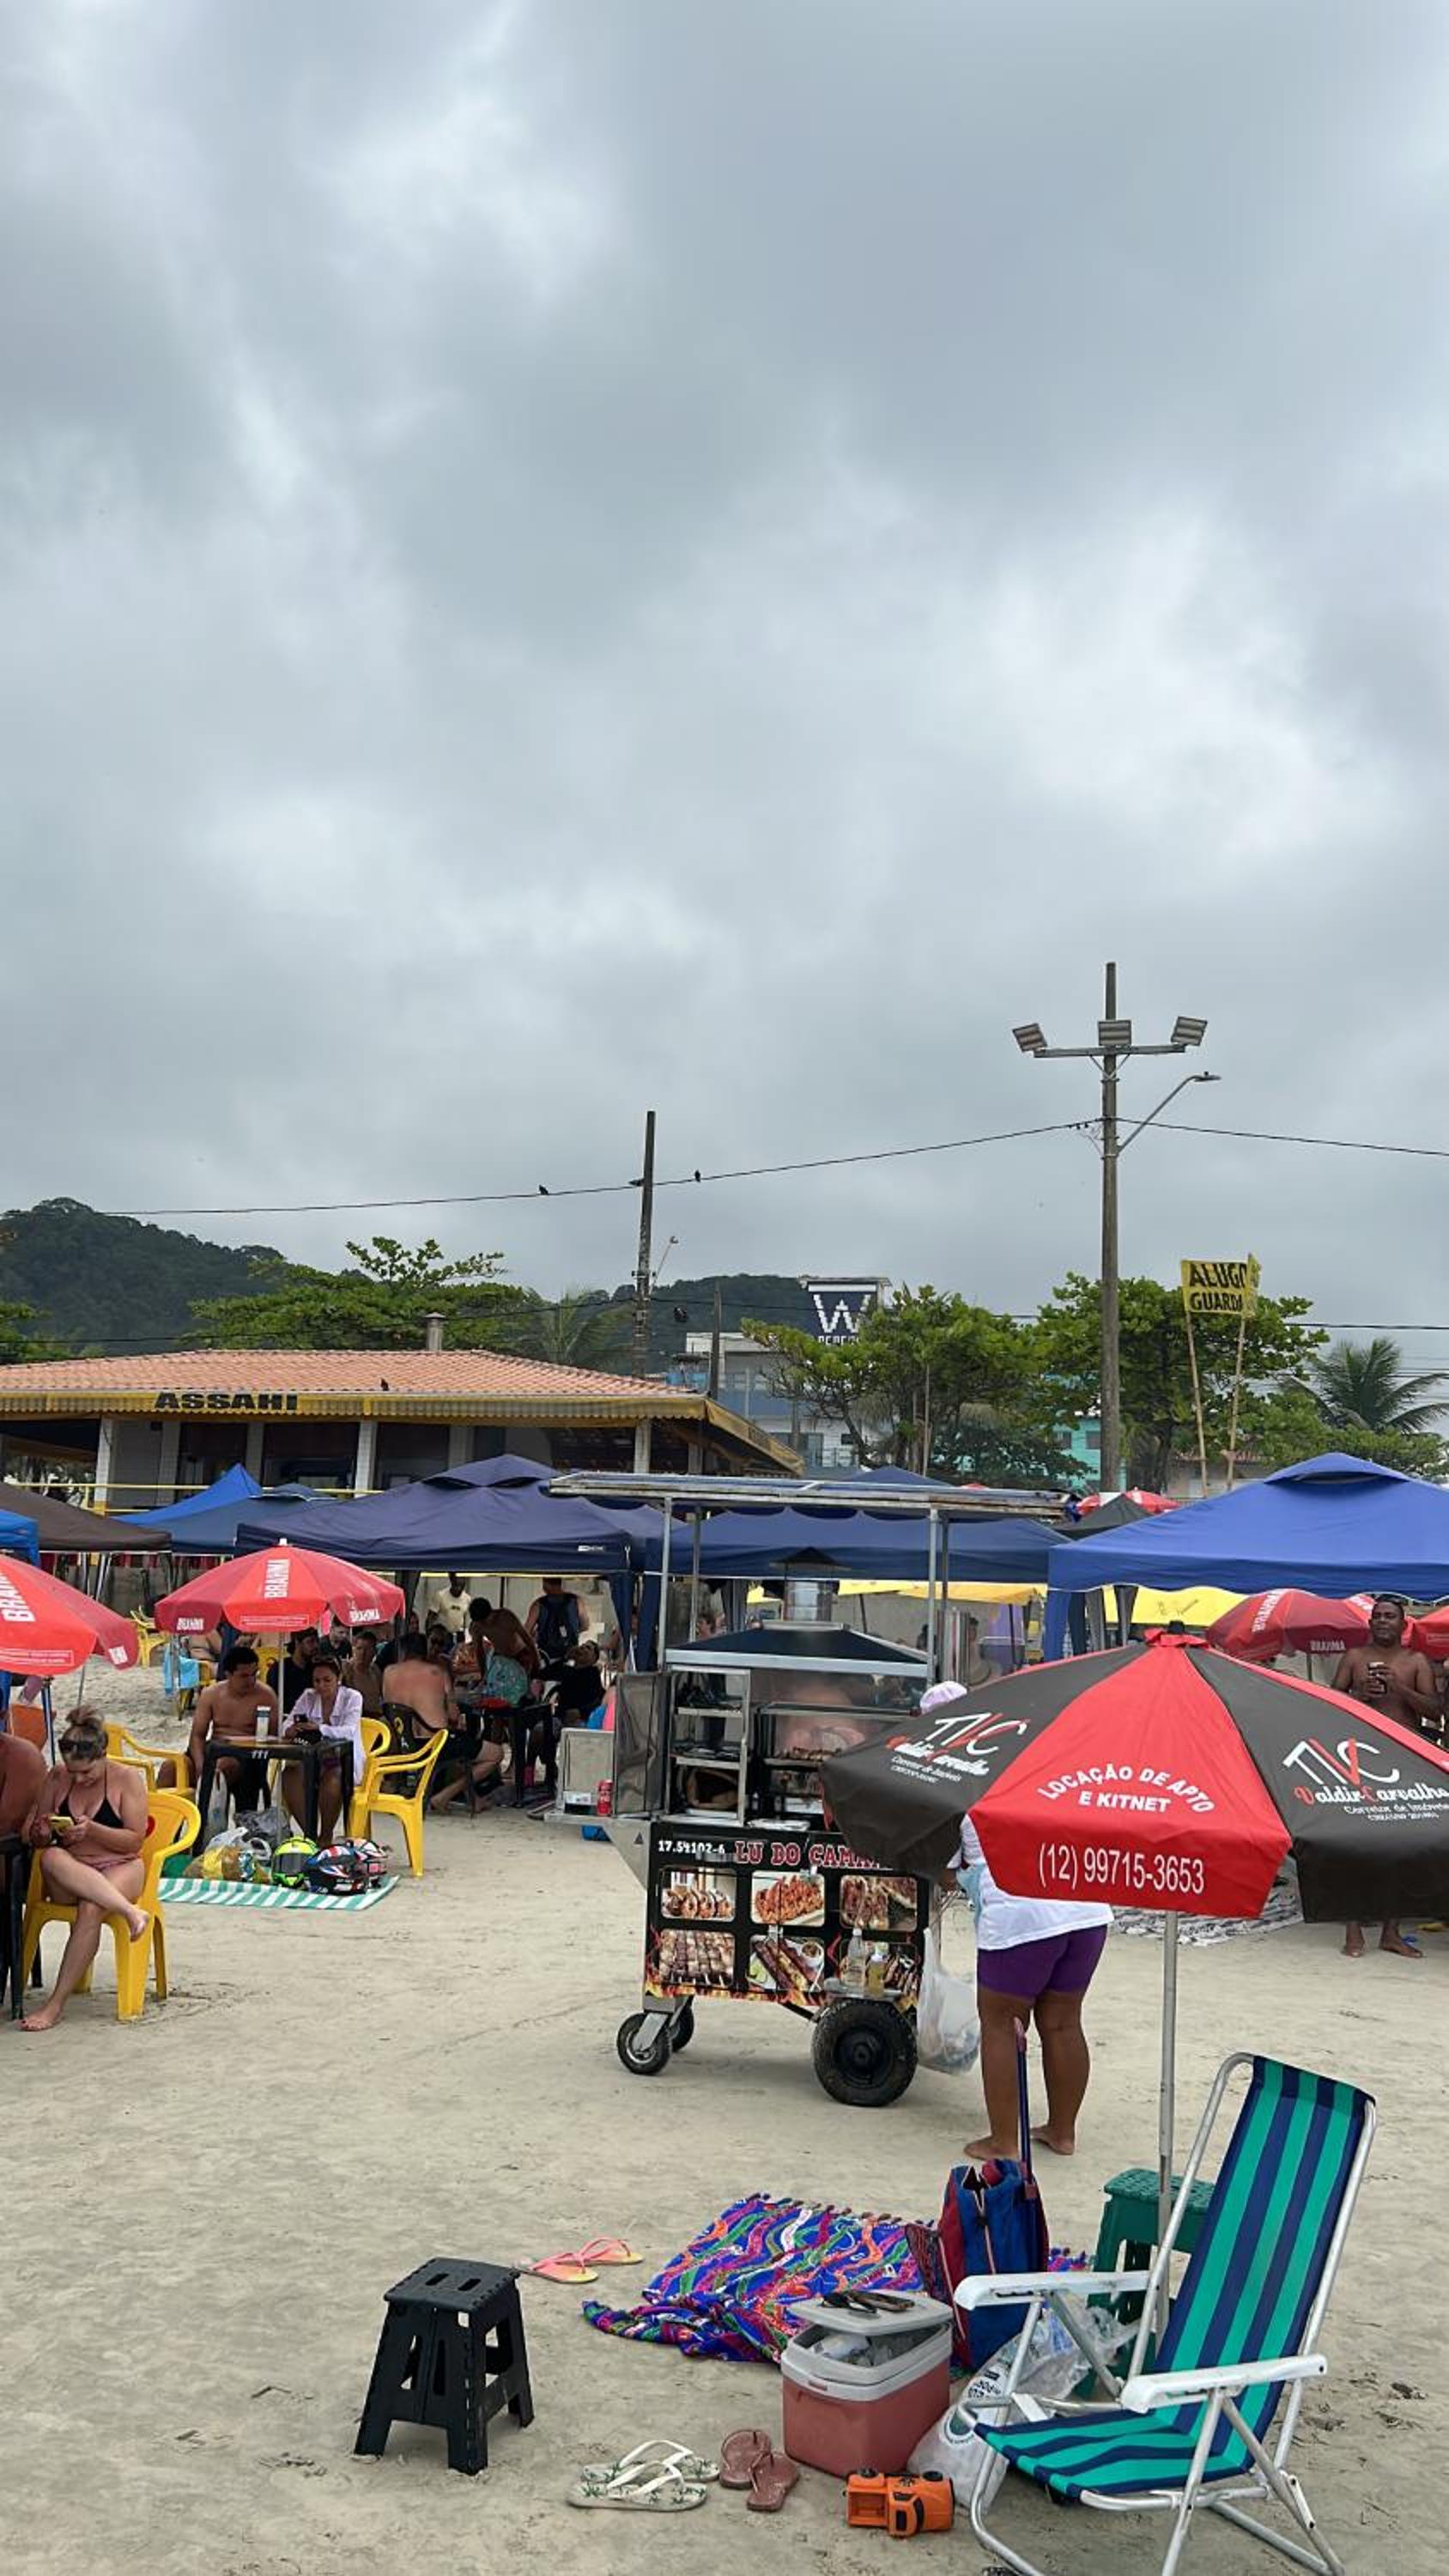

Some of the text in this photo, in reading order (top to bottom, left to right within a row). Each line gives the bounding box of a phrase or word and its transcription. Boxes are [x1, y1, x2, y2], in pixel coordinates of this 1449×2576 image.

[154, 1392, 298, 1411] ASSAHI
[1037, 1763, 1216, 1813] LOCAÇÃO DE APTO
[1294, 1783, 1365, 1807] Valdir
[1078, 1790, 1172, 1813] E KITNET
[735, 1840, 764, 1864] LU
[771, 1843, 800, 1865] DO
[1039, 1843, 1204, 1894] (12) 99715-3653
